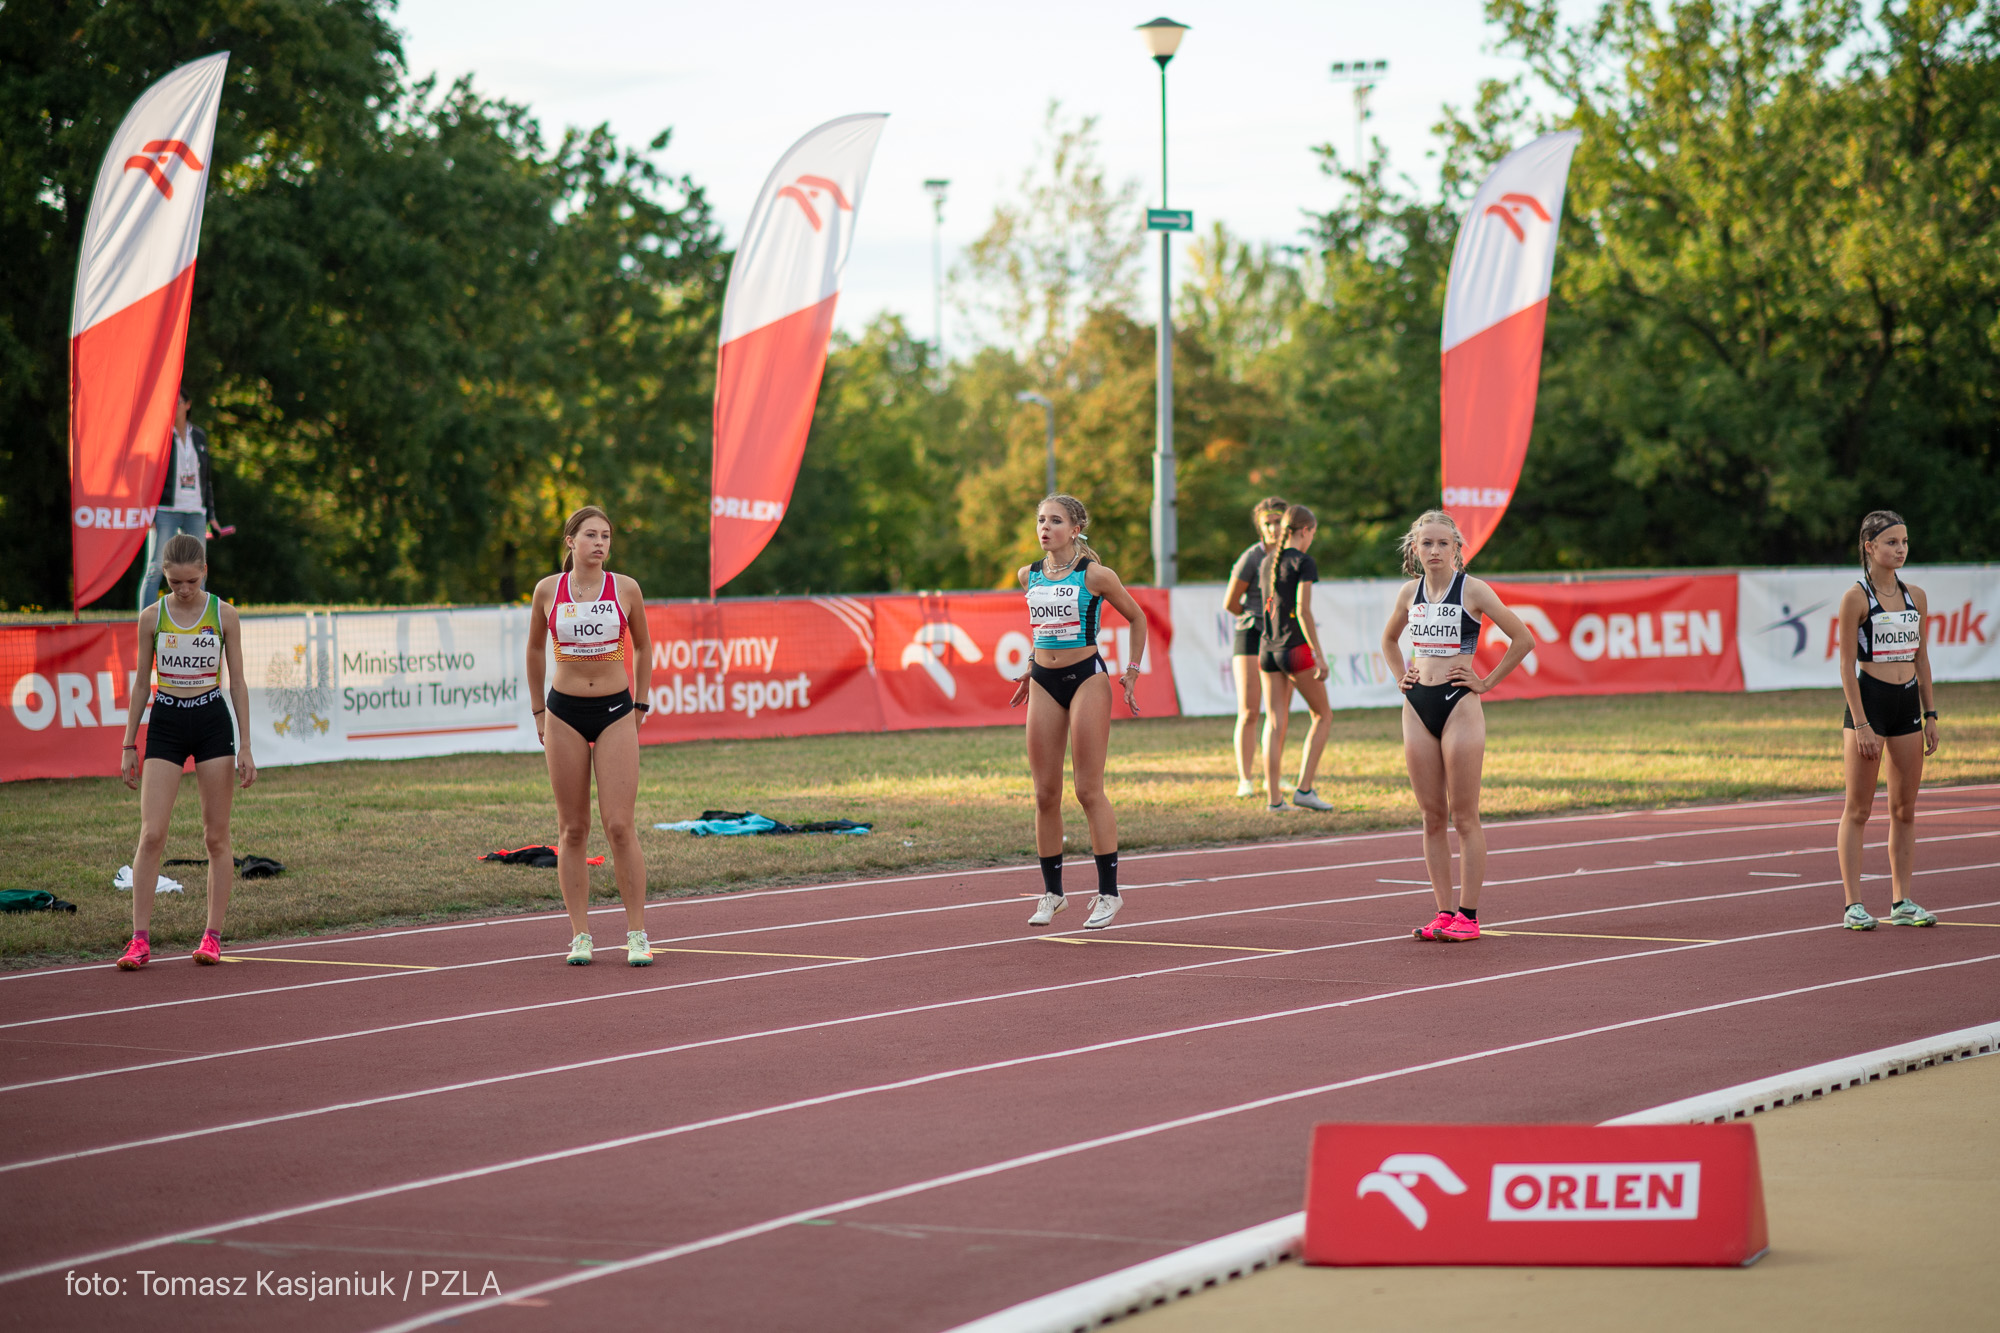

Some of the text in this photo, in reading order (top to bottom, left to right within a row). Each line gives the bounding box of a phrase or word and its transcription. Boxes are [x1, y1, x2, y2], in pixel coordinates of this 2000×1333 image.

[1442, 486, 1509, 507] ORLEN
[711, 495, 783, 521] ORLEN
[74, 505, 157, 529] ORLEN
[591, 603, 613, 614] 494
[1031, 605, 1072, 617] DONIEC
[1437, 607, 1456, 617] 186
[1900, 613, 1919, 623] 736
[574, 623, 603, 636] HOC
[1569, 609, 1722, 662] ORLEN
[192, 637, 215, 648] 464
[1874, 631, 1919, 644] MOLENDA
[161, 655, 215, 668] MARZEC
[343, 650, 475, 675] Ministerstwo
[343, 677, 518, 715] Sportu i Turystyki
[731, 671, 811, 718] sport
[177, 695, 208, 708] NIKE
[1504, 1173, 1684, 1210] ORLEN
